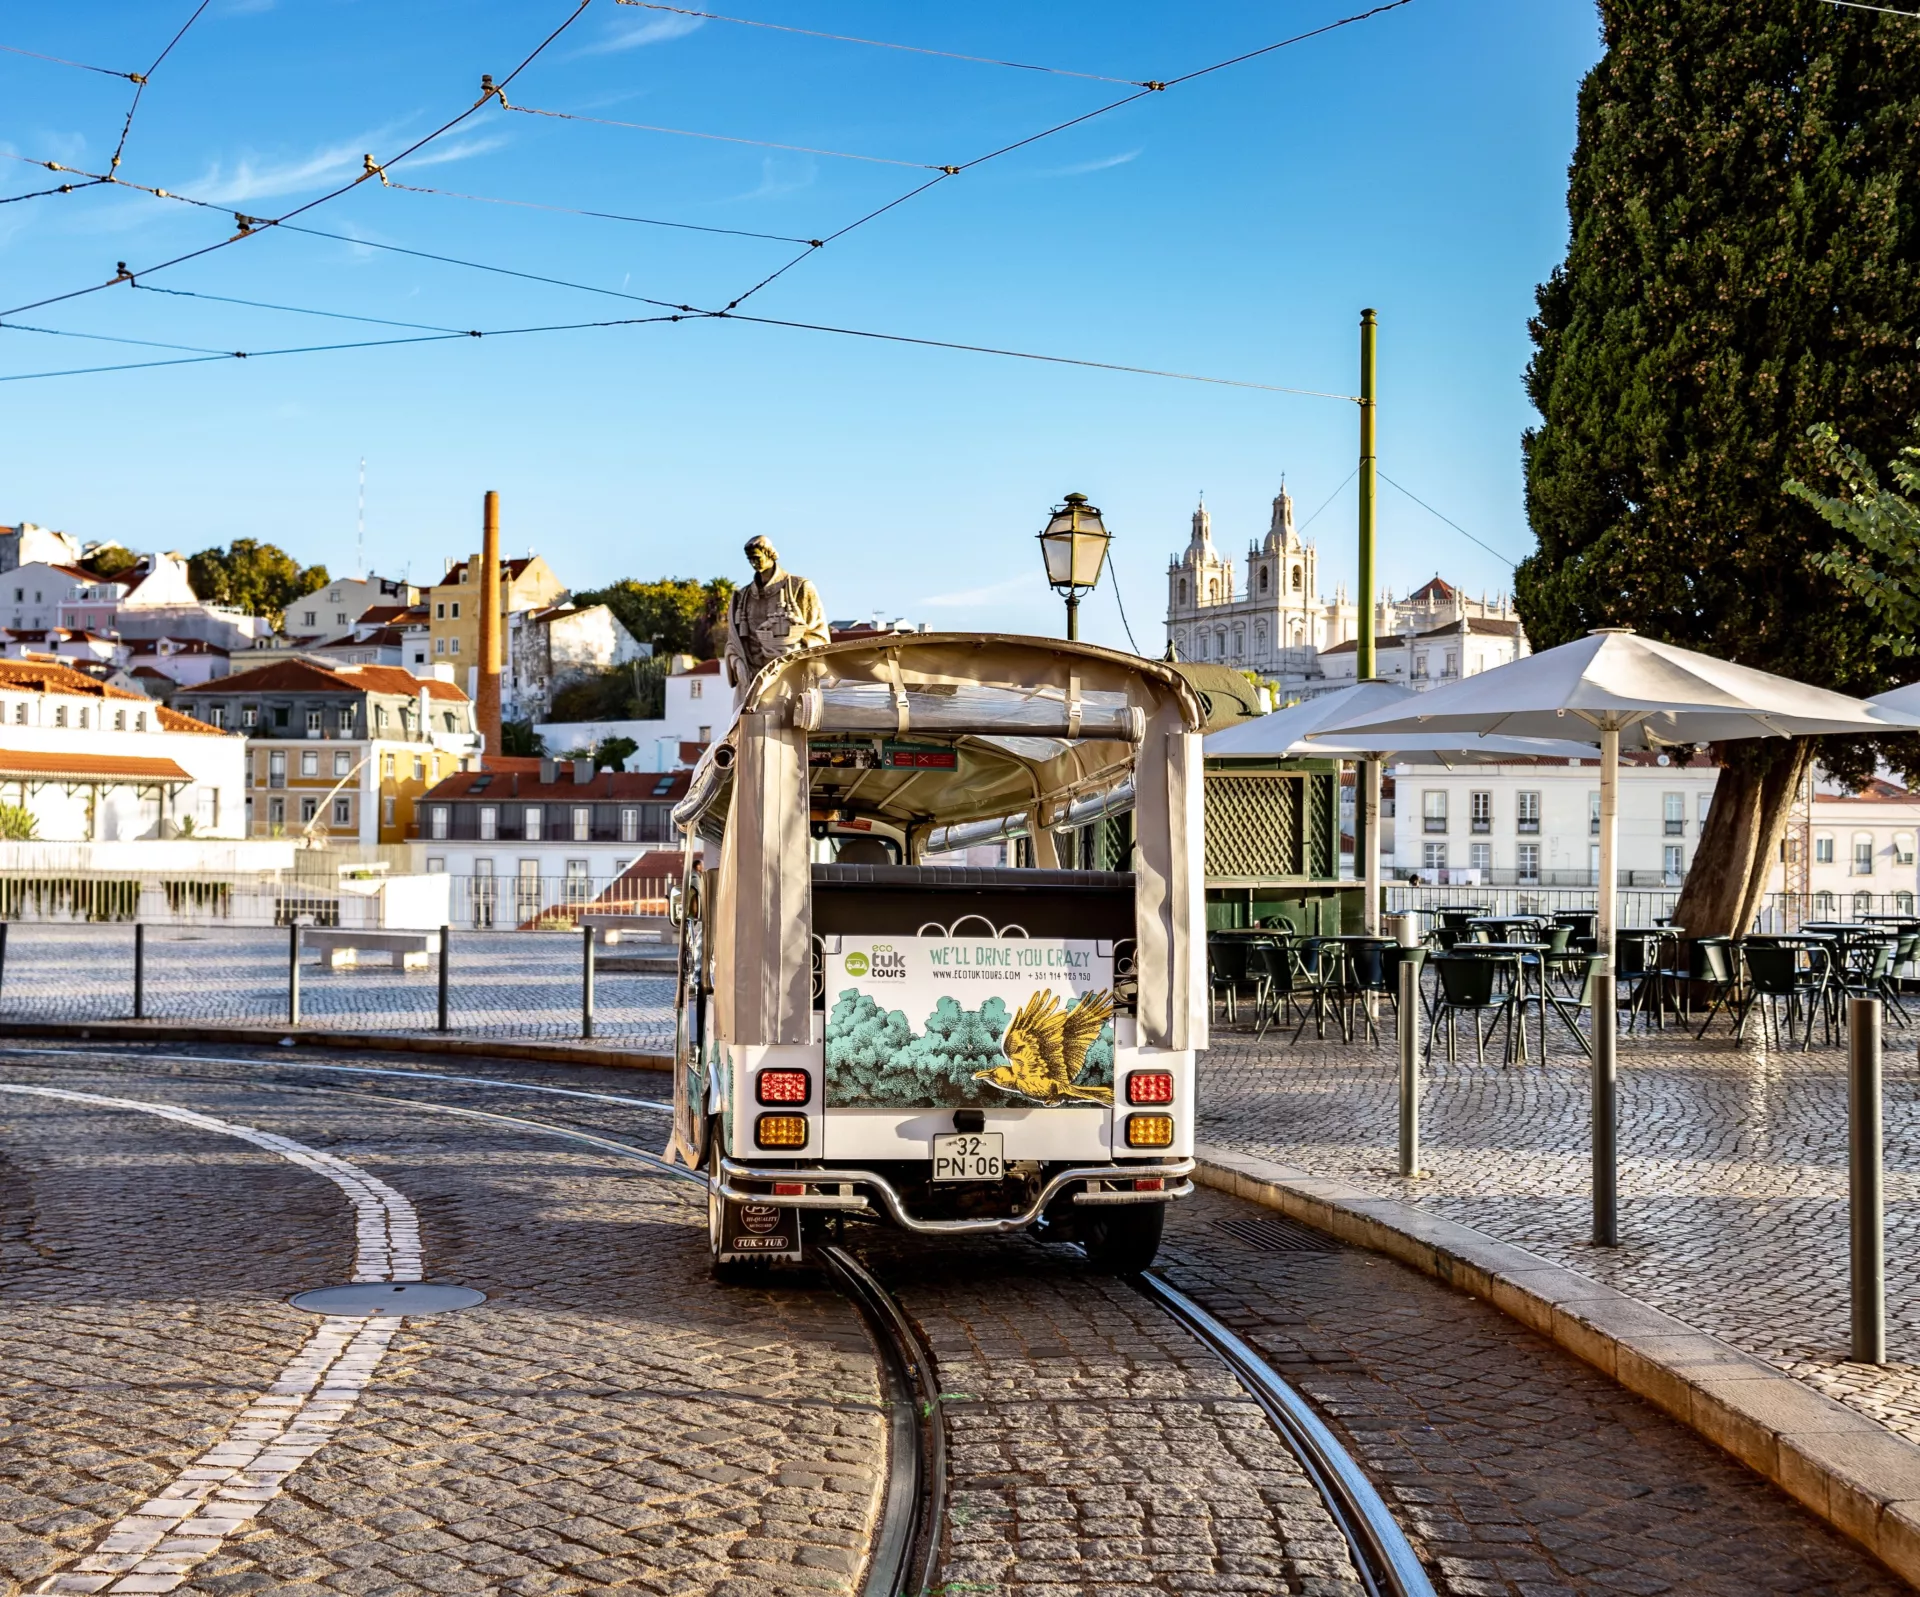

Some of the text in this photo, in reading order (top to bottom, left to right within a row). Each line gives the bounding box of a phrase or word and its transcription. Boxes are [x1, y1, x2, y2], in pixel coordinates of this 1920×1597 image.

[872, 944, 893, 952] eco
[871, 951, 906, 968] tuk
[929, 946, 1090, 967] WE'LL DRIVE YOU CRAZY
[871, 967, 906, 978] tours
[932, 969, 1021, 980] WWW.ECOTUKTOURS.COM
[956, 1136, 980, 1156] 32
